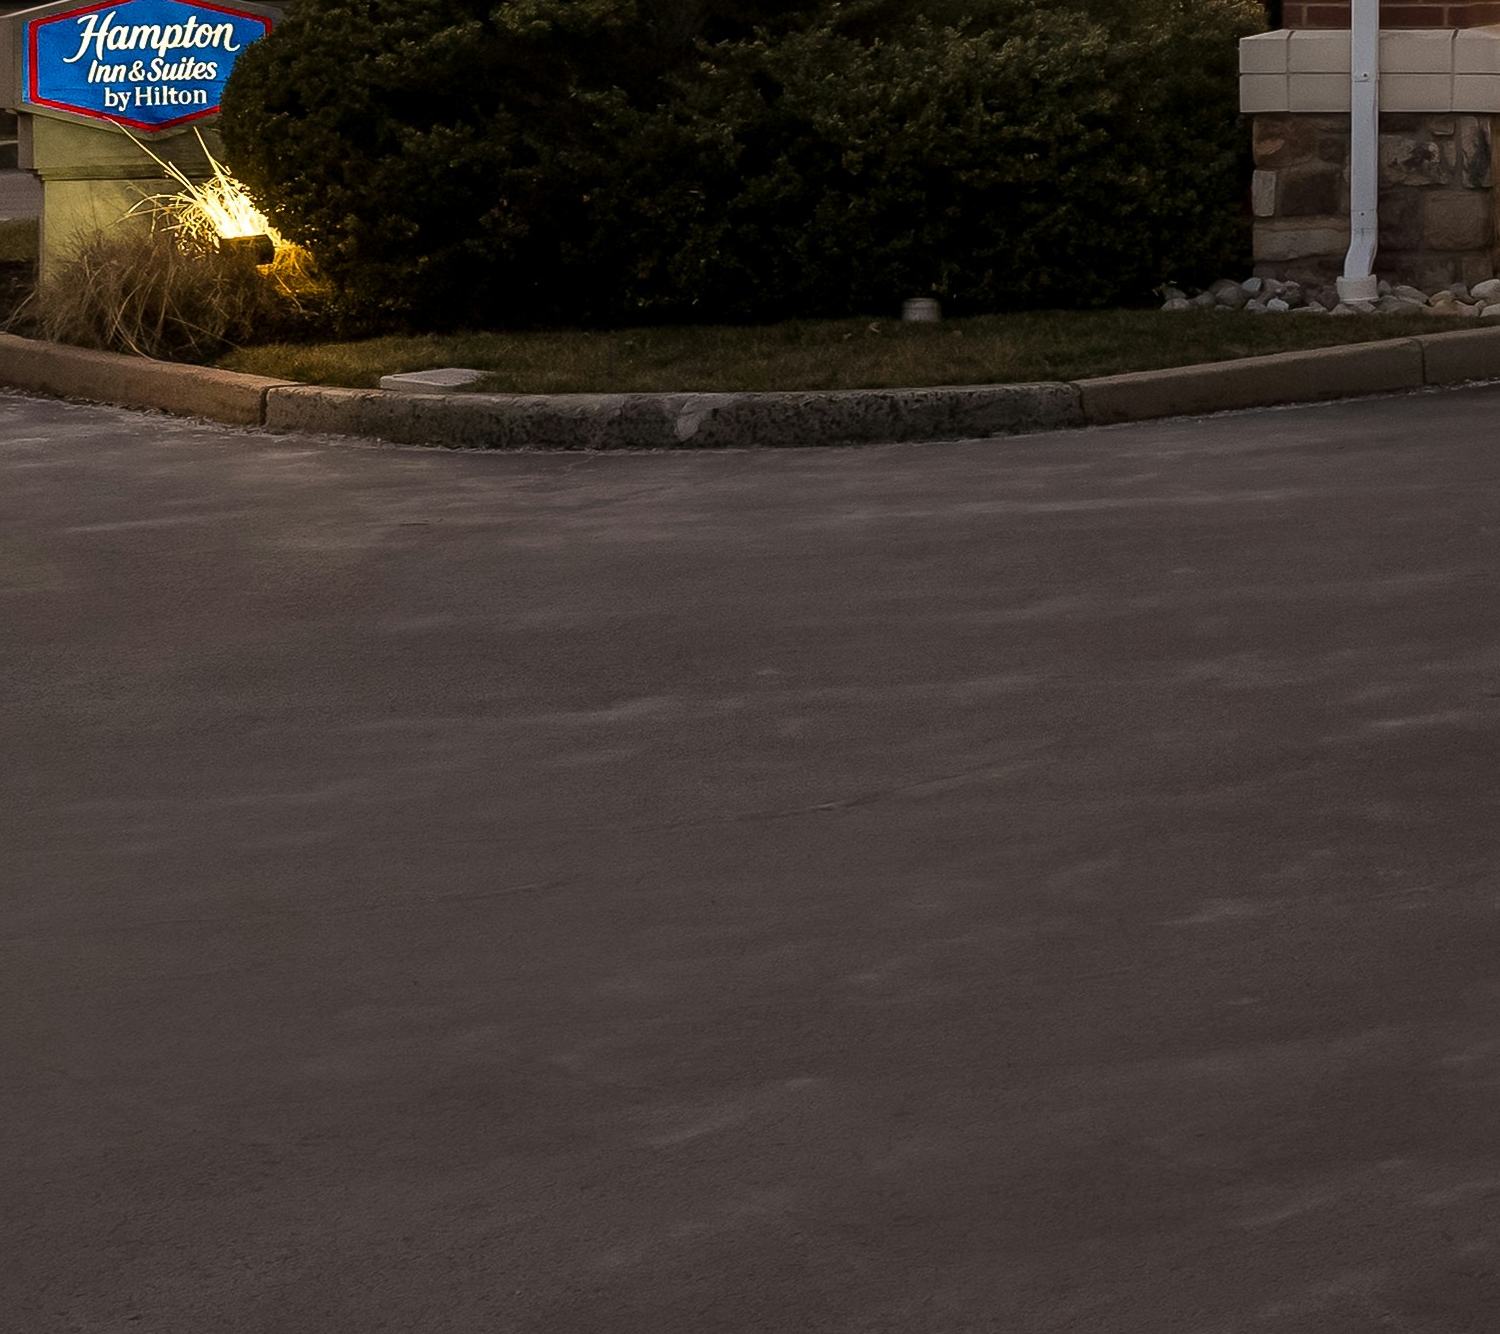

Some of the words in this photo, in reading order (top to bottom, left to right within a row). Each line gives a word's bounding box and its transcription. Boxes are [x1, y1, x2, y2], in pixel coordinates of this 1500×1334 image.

[63, 11, 240, 63] Hampton
[87, 59, 126, 83] Inn
[146, 57, 218, 82] Suites
[104, 88, 131, 111] by
[135, 85, 208, 107] Hilton
